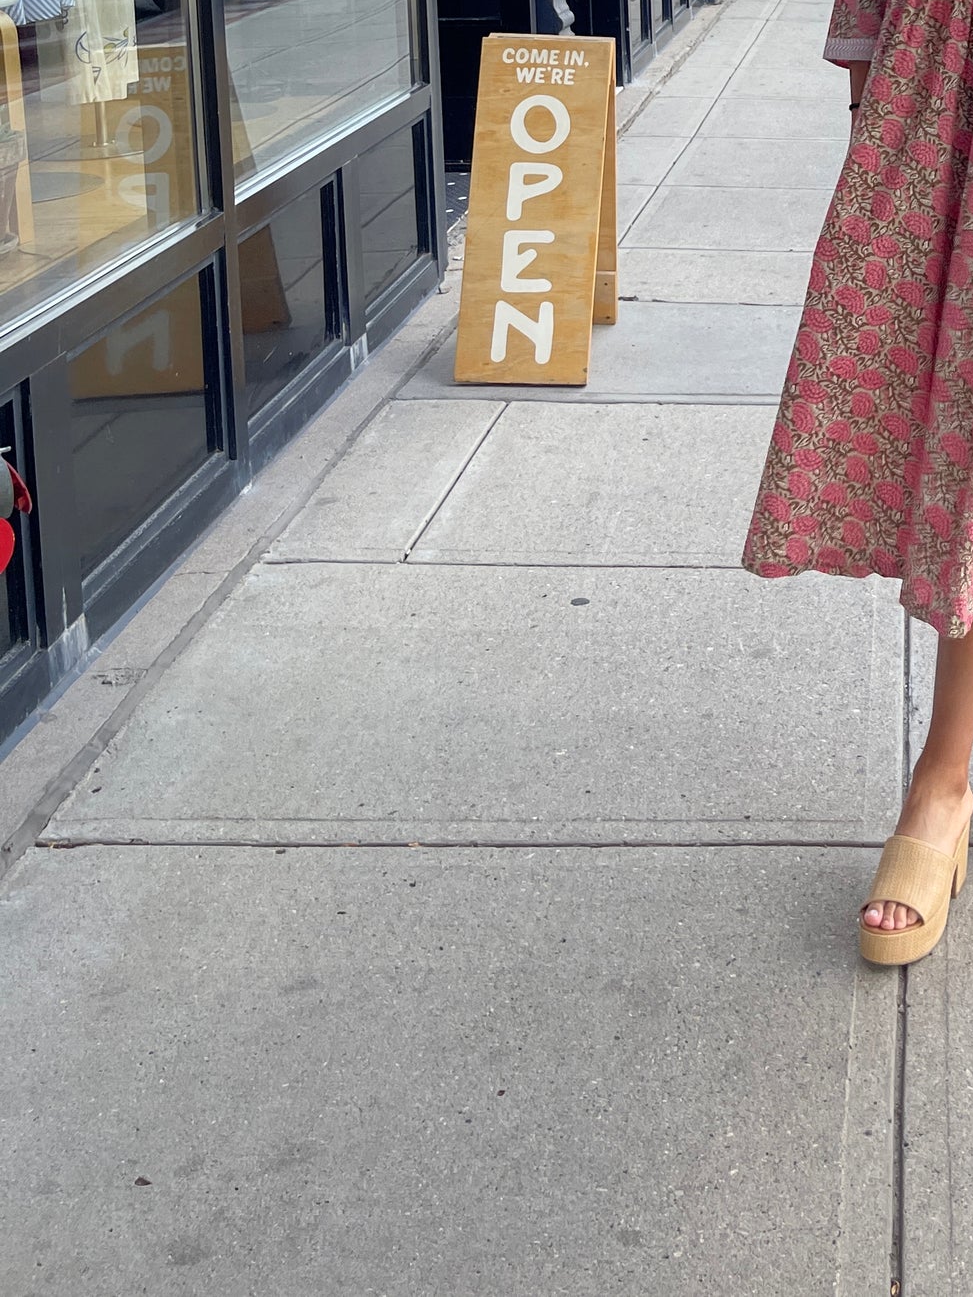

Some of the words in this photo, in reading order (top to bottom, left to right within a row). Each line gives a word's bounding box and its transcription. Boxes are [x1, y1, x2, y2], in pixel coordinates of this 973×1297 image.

[502, 48, 560, 66] COME
[563, 50, 589, 68] IN,
[516, 66, 576, 86] WE'RE
[491, 94, 571, 365] OPEN
